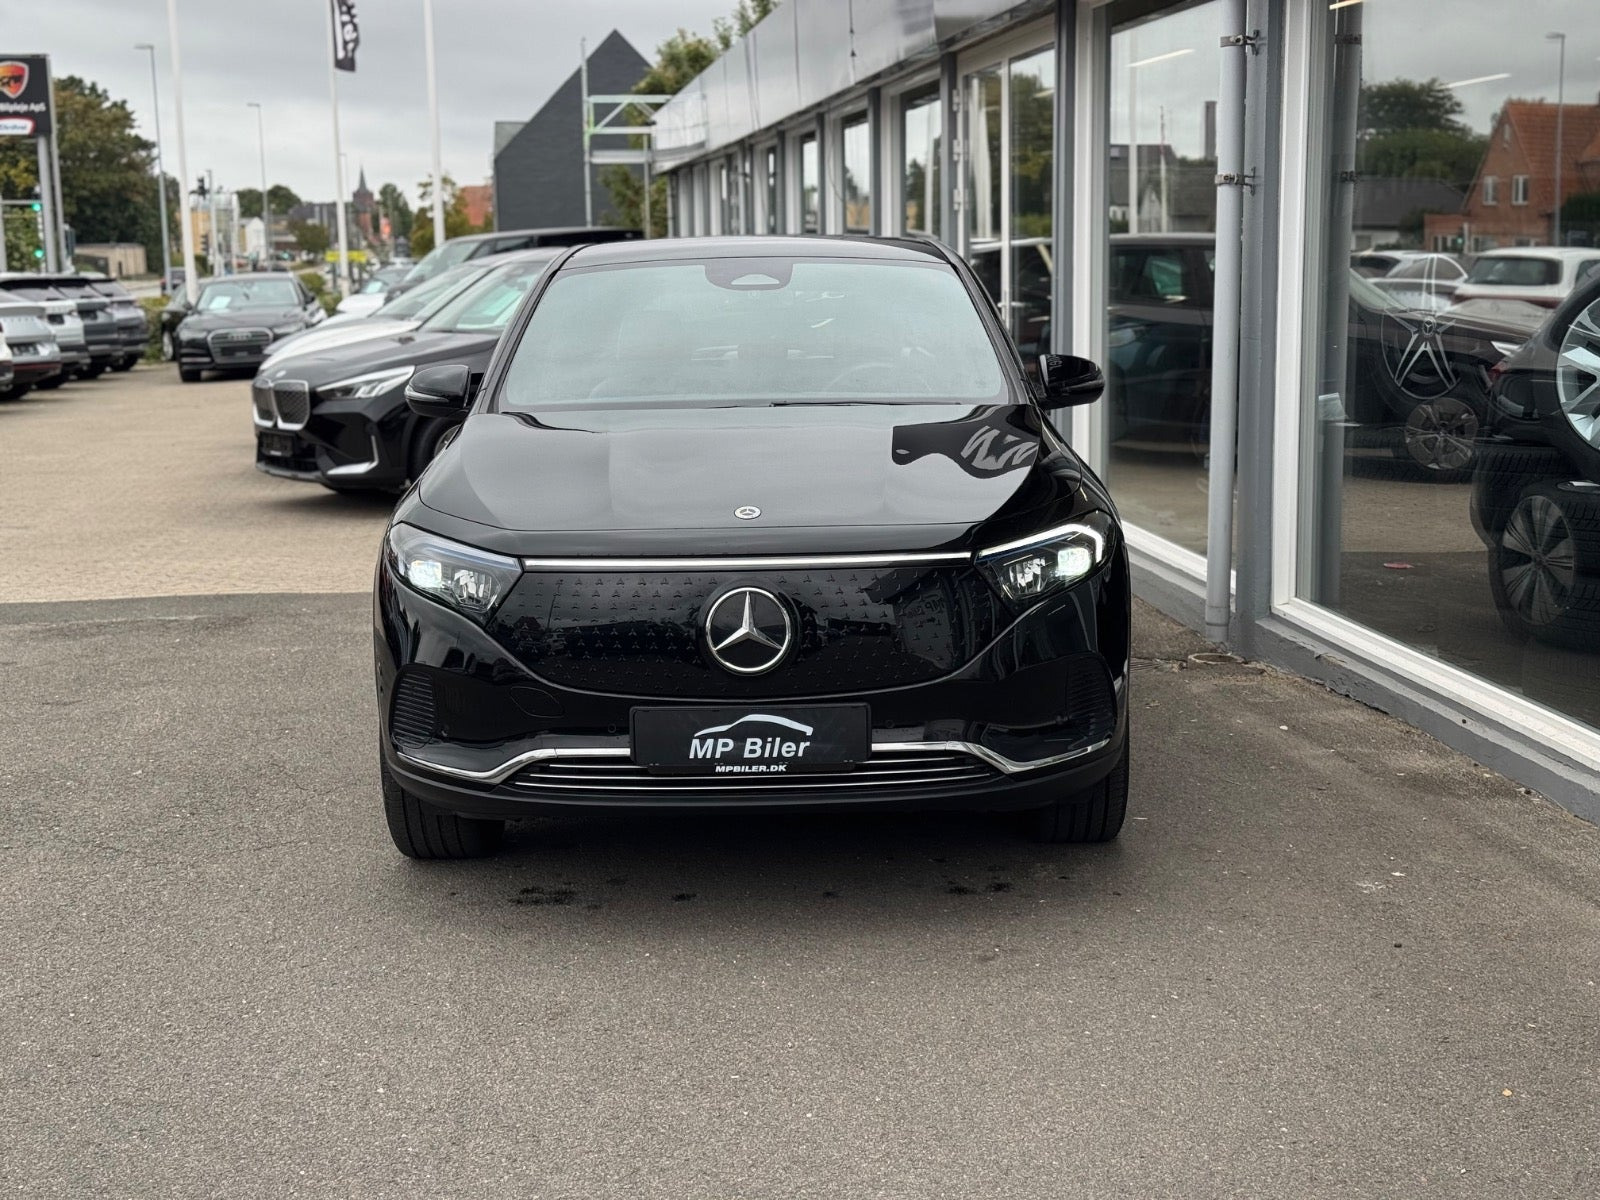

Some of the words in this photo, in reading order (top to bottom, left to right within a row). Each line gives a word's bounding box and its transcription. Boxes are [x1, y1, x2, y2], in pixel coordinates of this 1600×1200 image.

[29, 102, 46, 113] ApS
[689, 738, 734, 759] MP
[743, 737, 810, 758] Biler
[715, 764, 787, 773] MPBILER.DK
